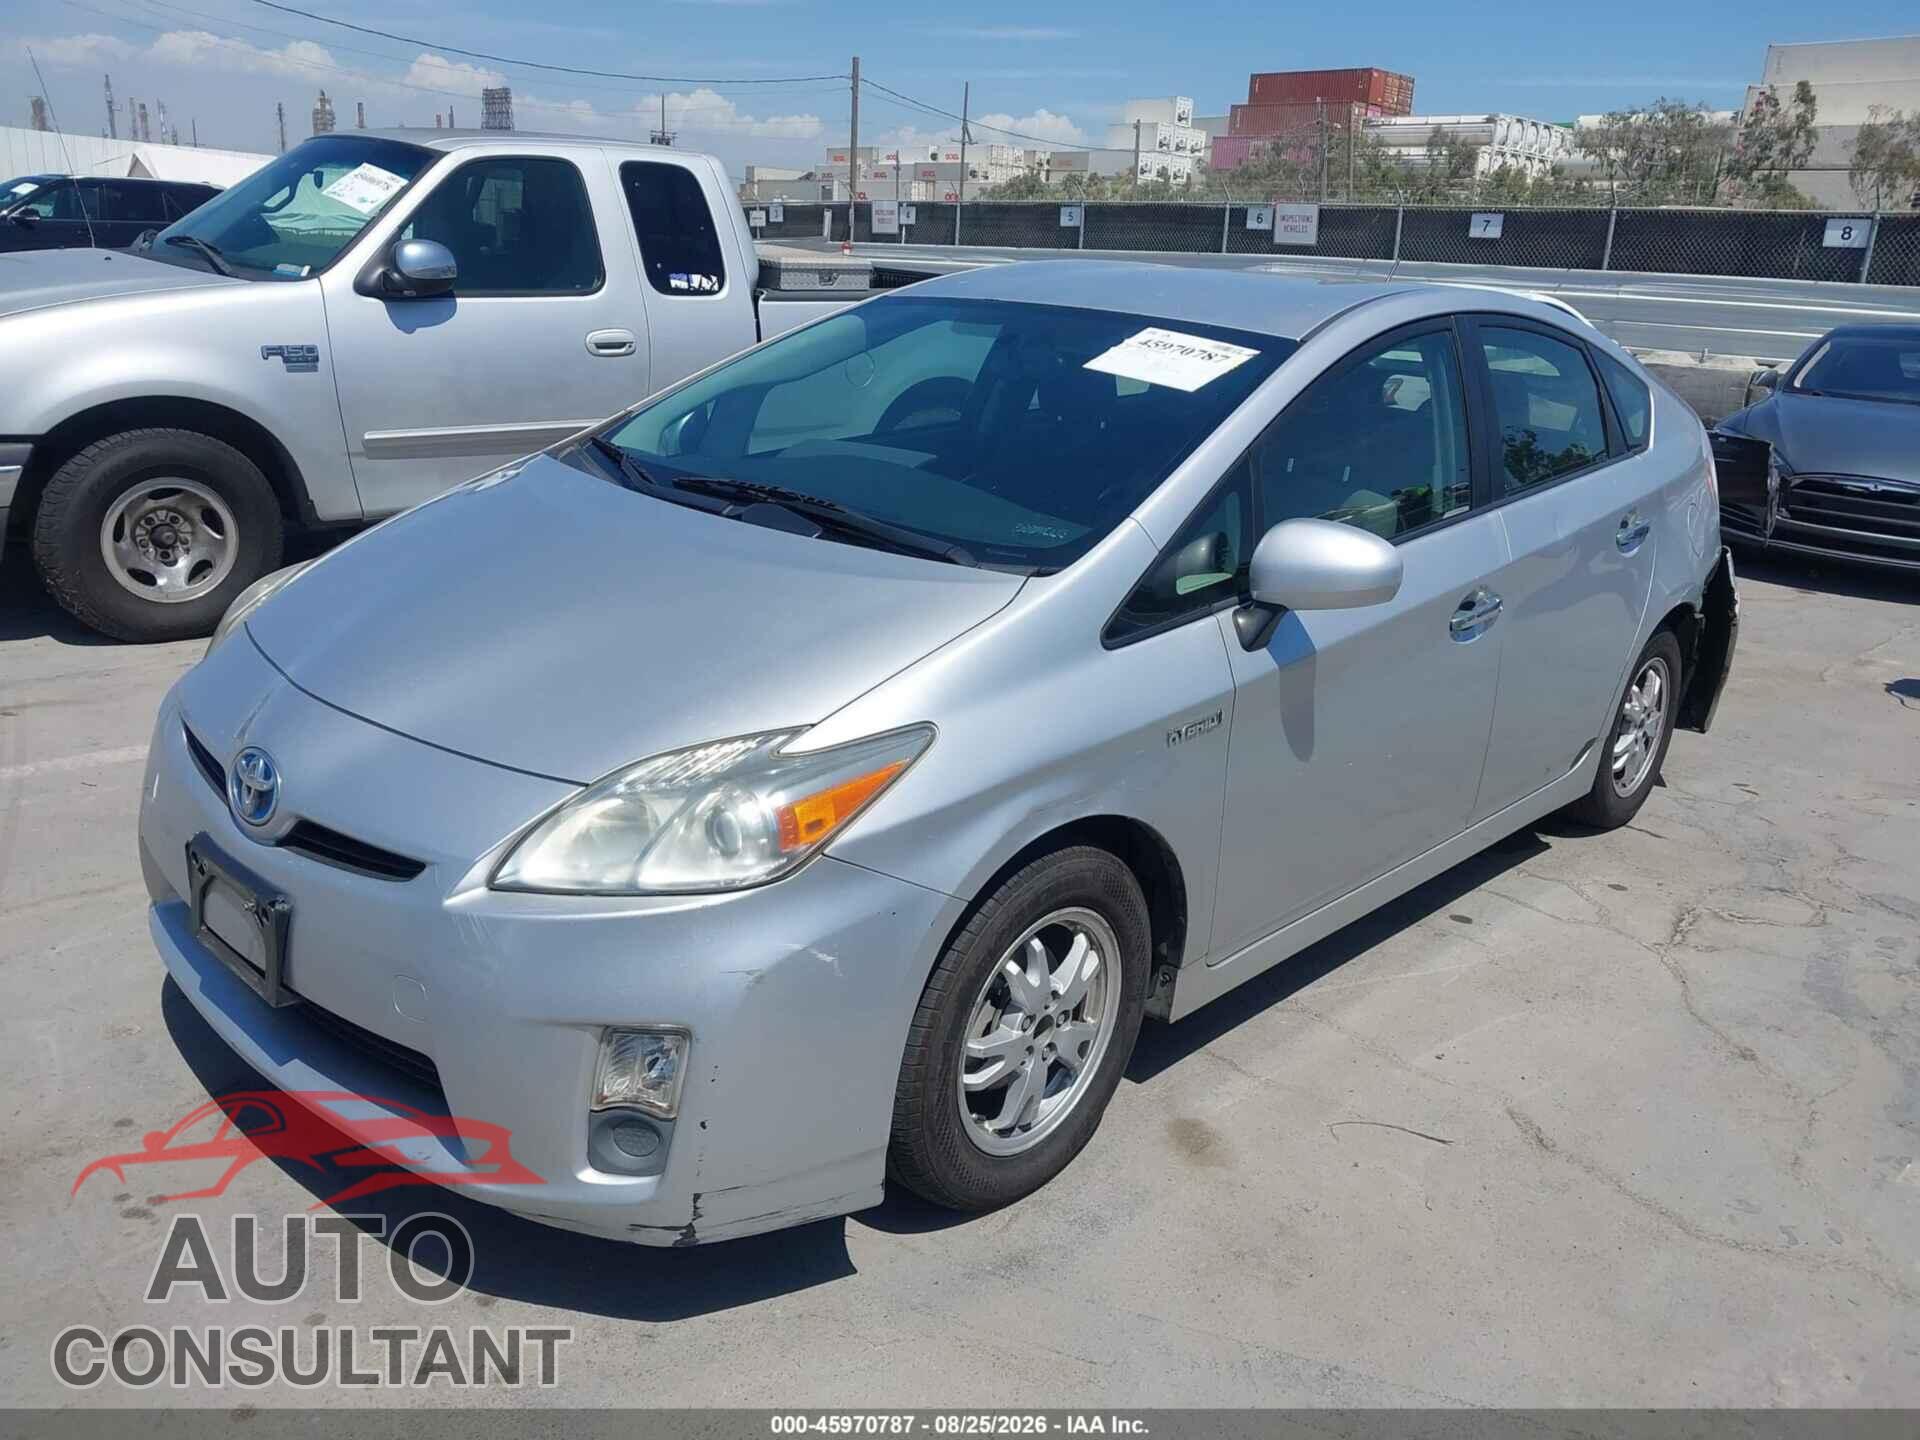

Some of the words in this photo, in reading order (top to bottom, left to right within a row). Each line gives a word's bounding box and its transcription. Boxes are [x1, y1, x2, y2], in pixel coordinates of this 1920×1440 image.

[1067, 210, 1074, 222] 5
[1256, 212, 1264, 224] 6
[1482, 219, 1491, 233] 7
[1841, 225, 1853, 240] 8
[1139, 338, 1231, 363] 45970787
